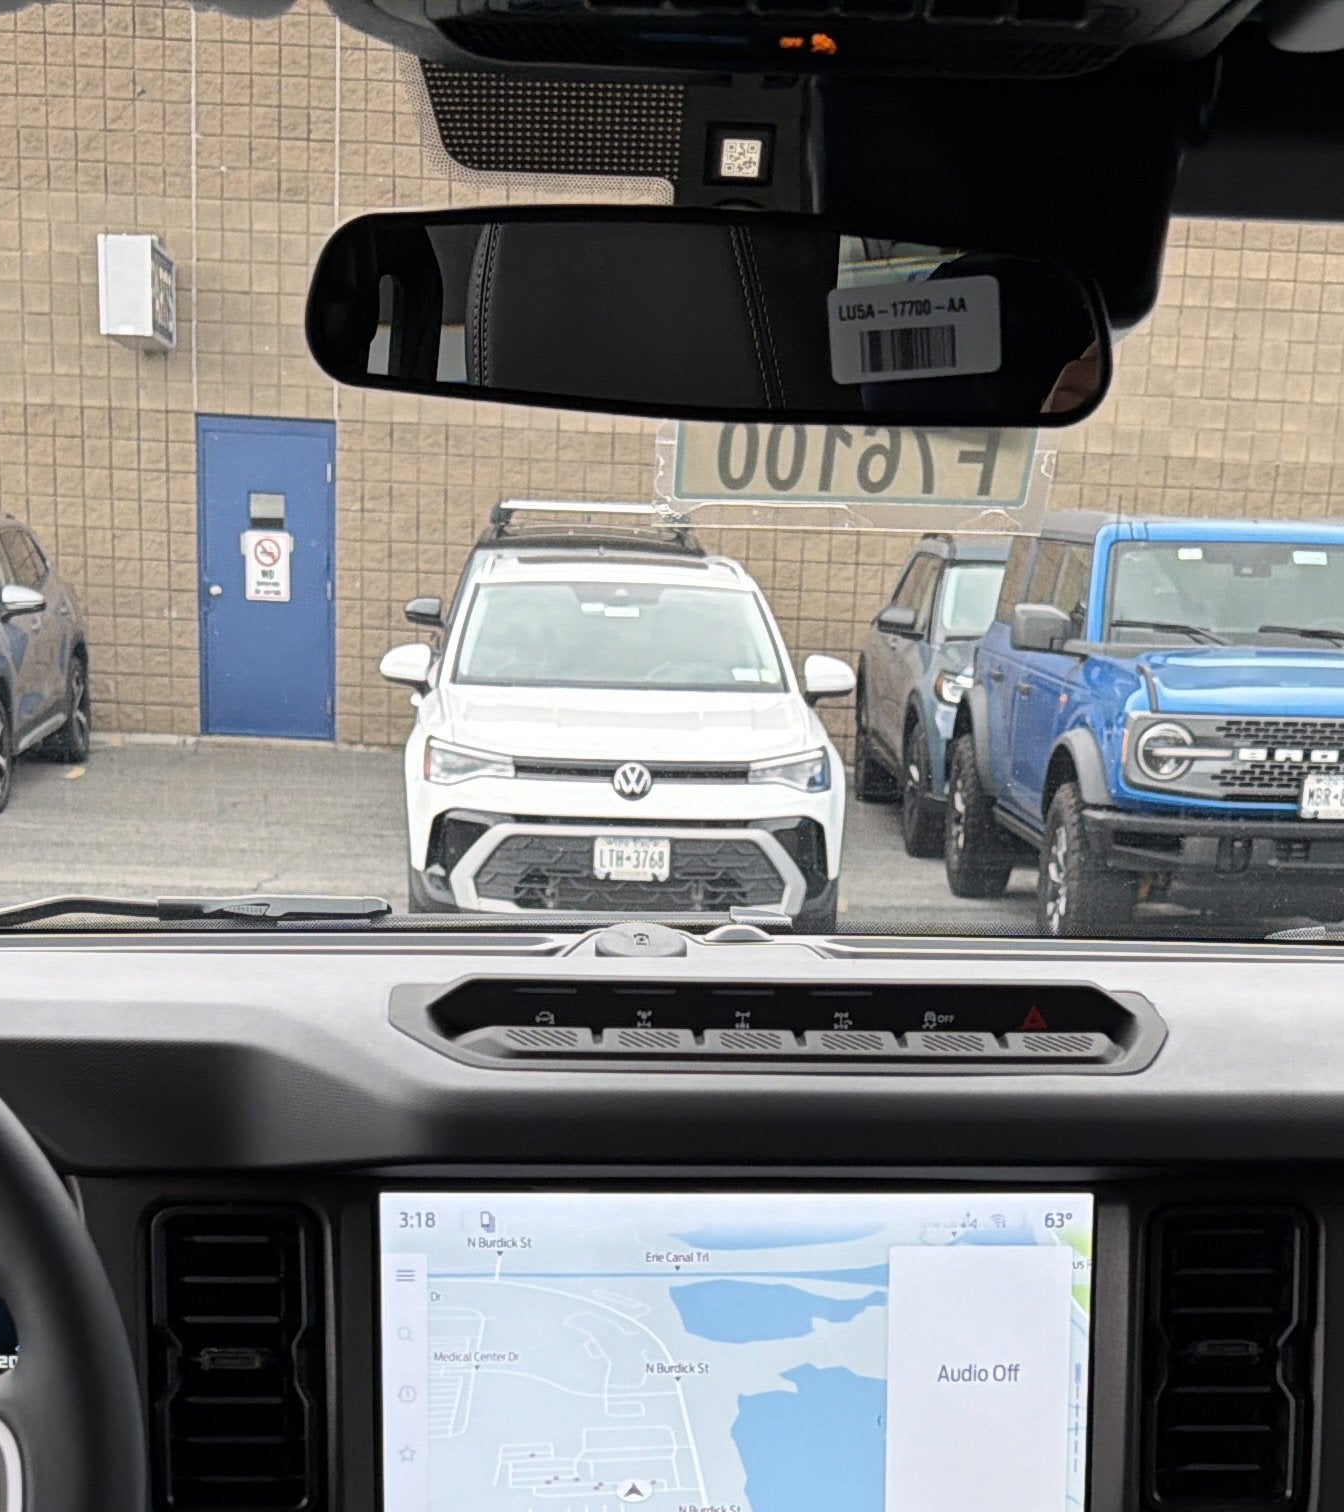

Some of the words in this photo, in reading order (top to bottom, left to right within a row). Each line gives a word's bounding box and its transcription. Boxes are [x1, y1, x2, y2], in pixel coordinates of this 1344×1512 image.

[399, 1211, 436, 1229] 3:18
[467, 1238, 476, 1248] N
[478, 1236, 518, 1249] Burdick
[520, 1237, 532, 1248] St
[646, 1251, 664, 1263] Erie
[667, 1251, 693, 1263] Canal
[434, 1351, 471, 1363] Medical
[474, 1351, 506, 1363] Center
[508, 1351, 519, 1363] Dr
[646, 1363, 653, 1374] N
[655, 1362, 694, 1375] Burdick
[697, 1363, 709, 1374] St
[937, 1363, 988, 1384] Audio
[992, 1362, 1020, 1384] Off
